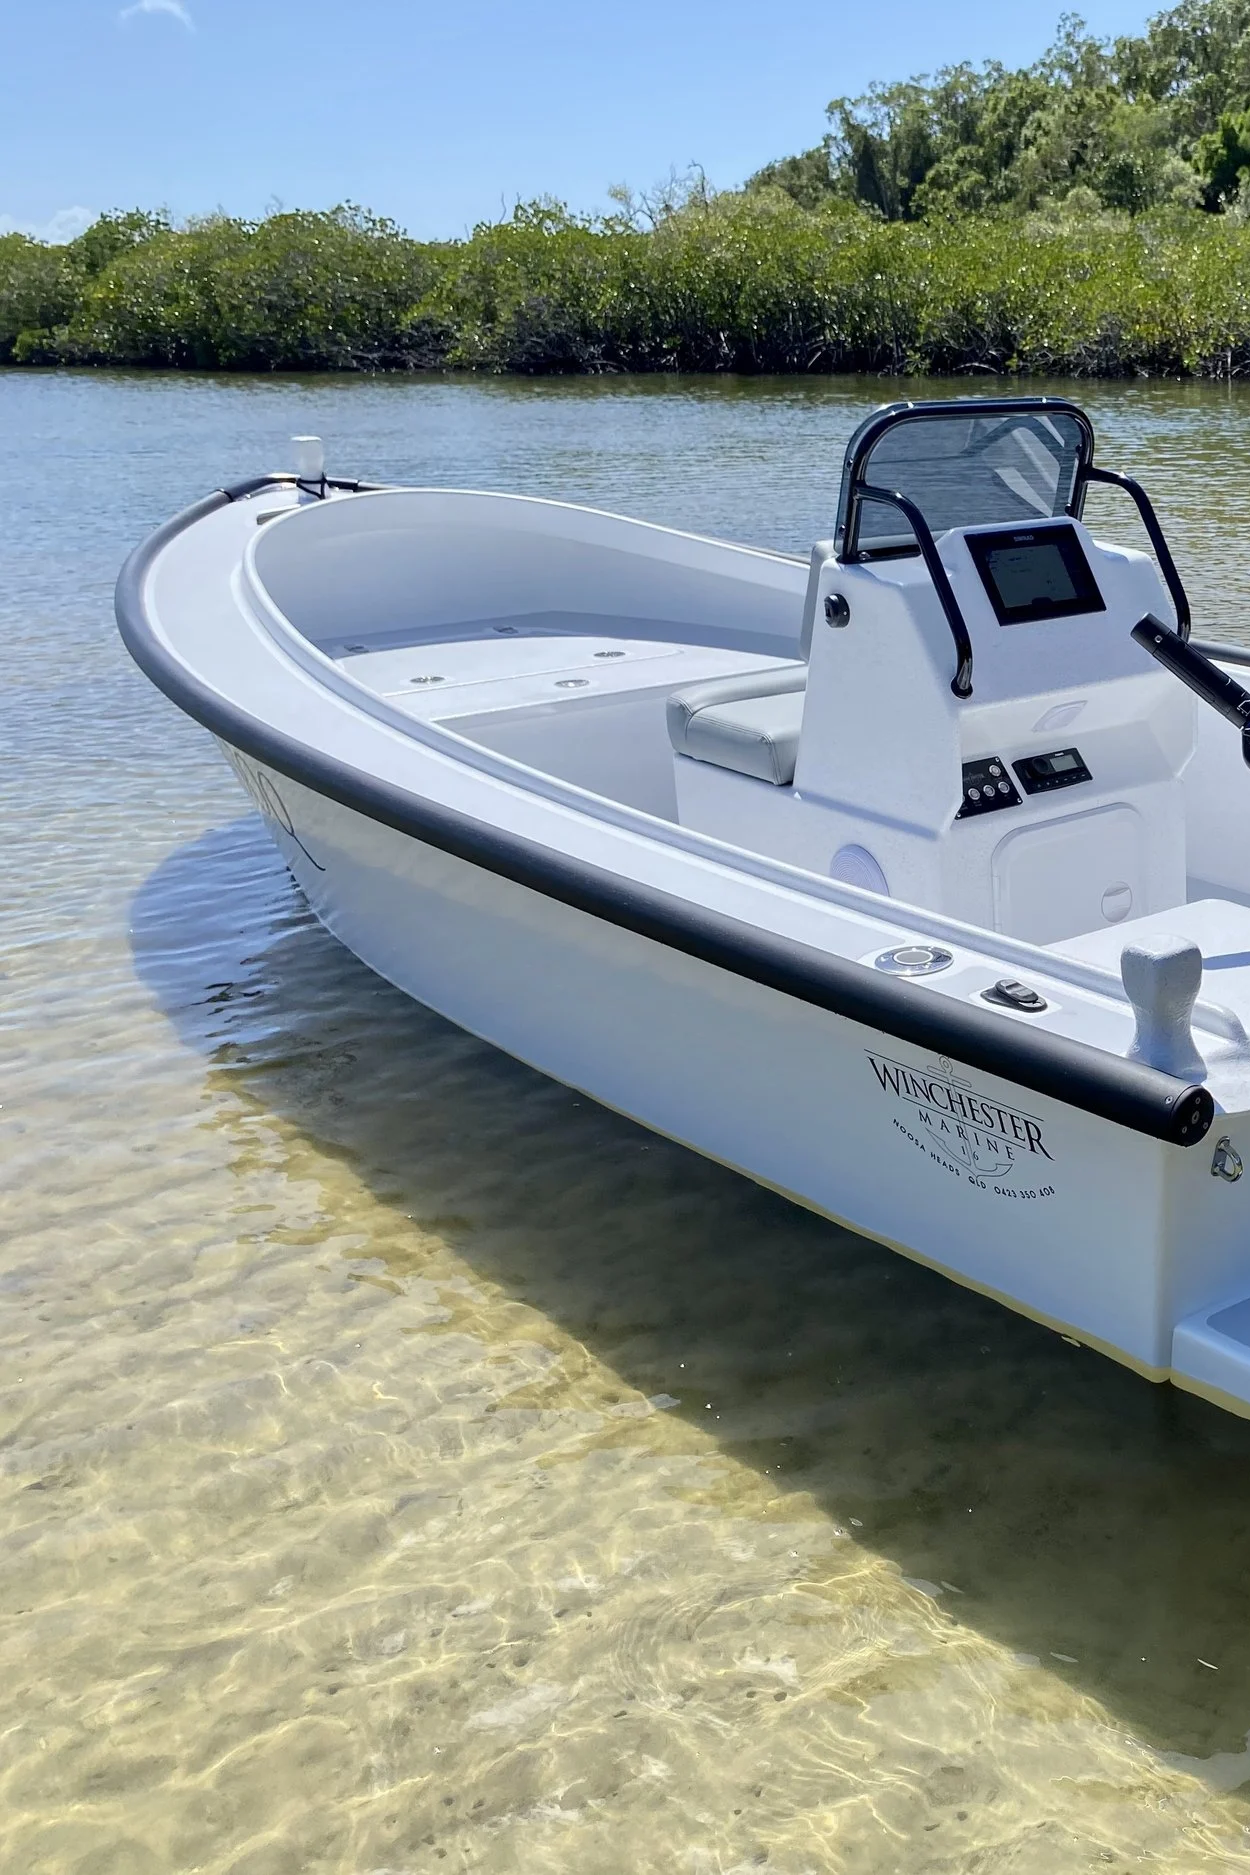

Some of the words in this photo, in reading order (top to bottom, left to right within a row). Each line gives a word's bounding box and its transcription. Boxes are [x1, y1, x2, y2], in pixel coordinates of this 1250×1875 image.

[867, 1056, 1055, 1161] WINCHESTER
[918, 1109, 1015, 1161] MARINE
[893, 1118, 926, 1152] NOOSA
[930, 1152, 960, 1176] HEADS
[968, 1175, 986, 1189] QLD
[994, 1186, 1017, 1198] 0423
